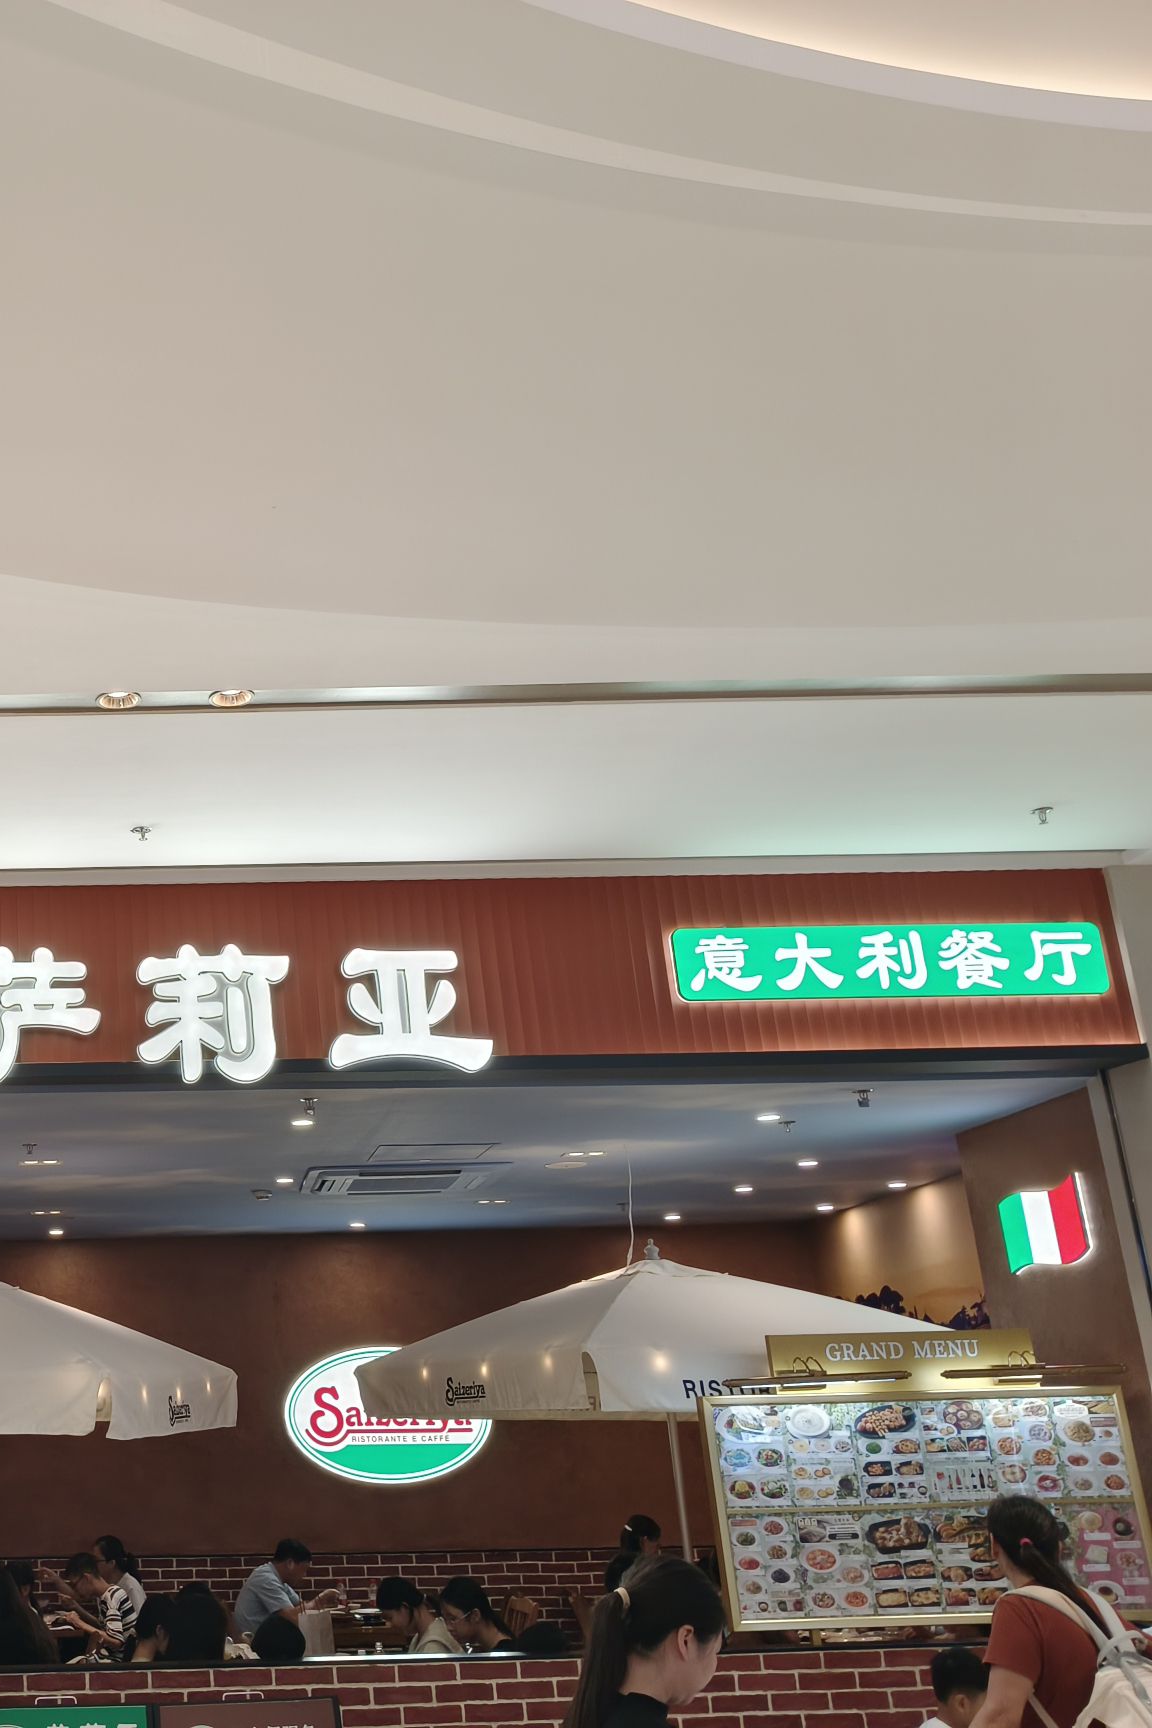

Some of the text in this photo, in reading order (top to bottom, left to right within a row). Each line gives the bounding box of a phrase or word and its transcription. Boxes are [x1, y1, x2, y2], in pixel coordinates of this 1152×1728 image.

[689, 928, 1093, 992] 意大利餐厅
[825, 1340, 979, 1361] GRAND MENU
[351, 1435, 407, 1443] RISTORANTE
